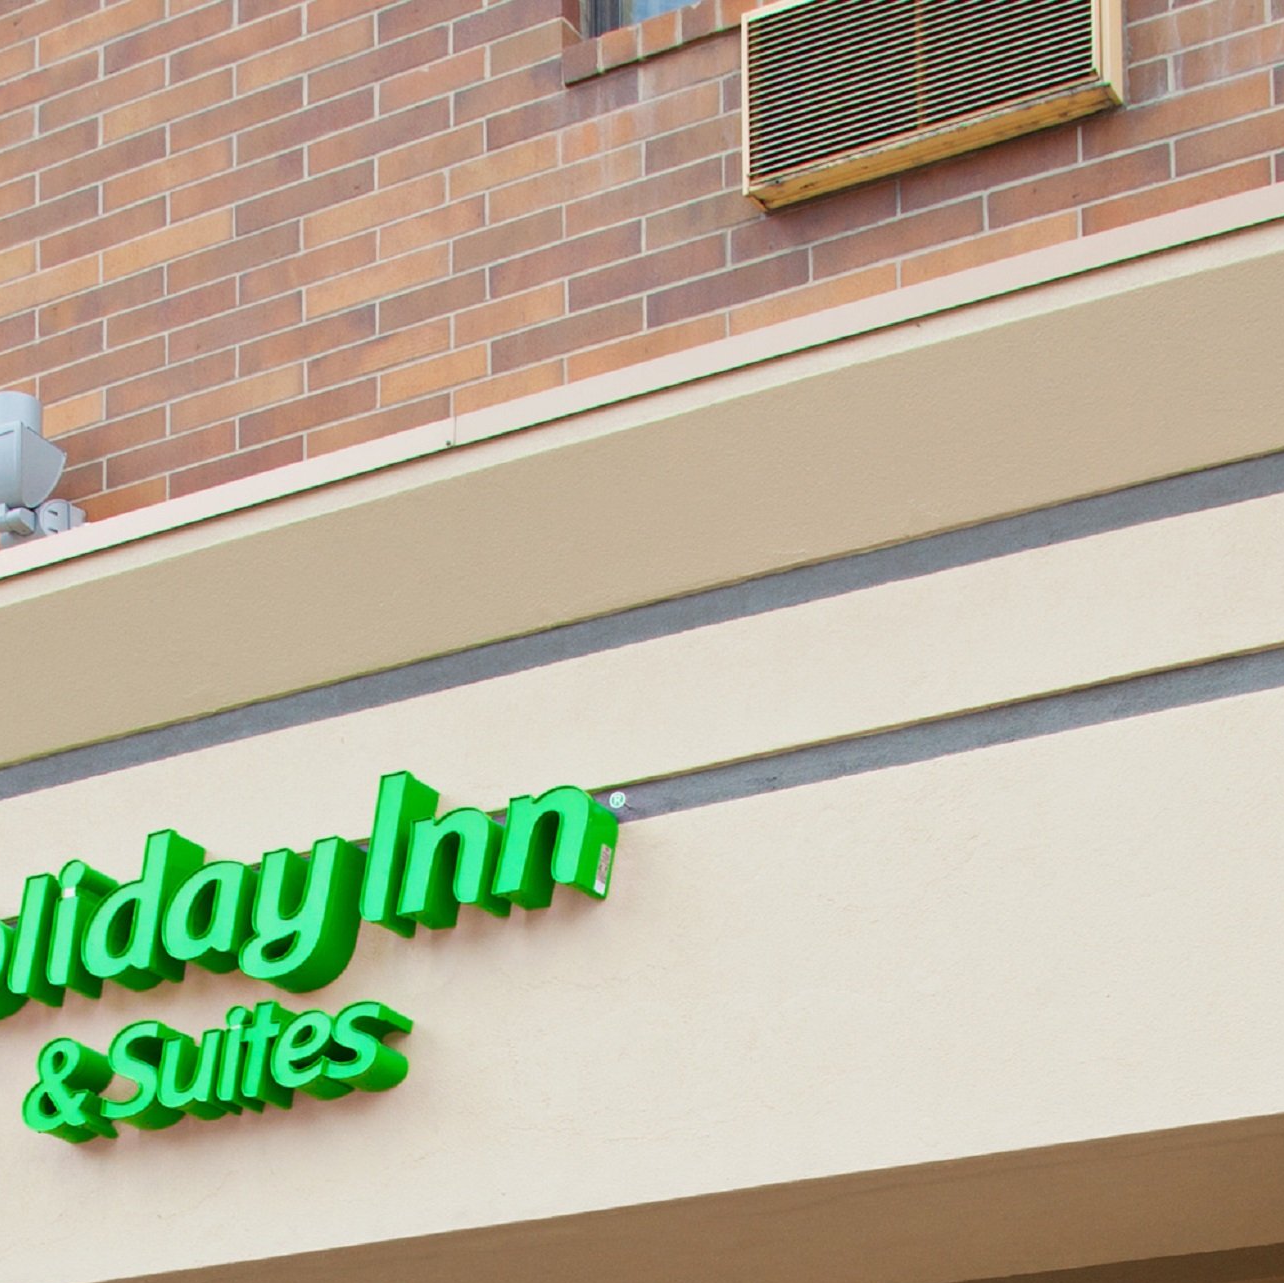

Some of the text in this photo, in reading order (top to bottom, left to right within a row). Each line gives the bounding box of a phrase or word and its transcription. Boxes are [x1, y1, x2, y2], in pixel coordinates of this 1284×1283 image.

[359, 771, 620, 937] Inn
[21, 1001, 413, 1144] & Suites
